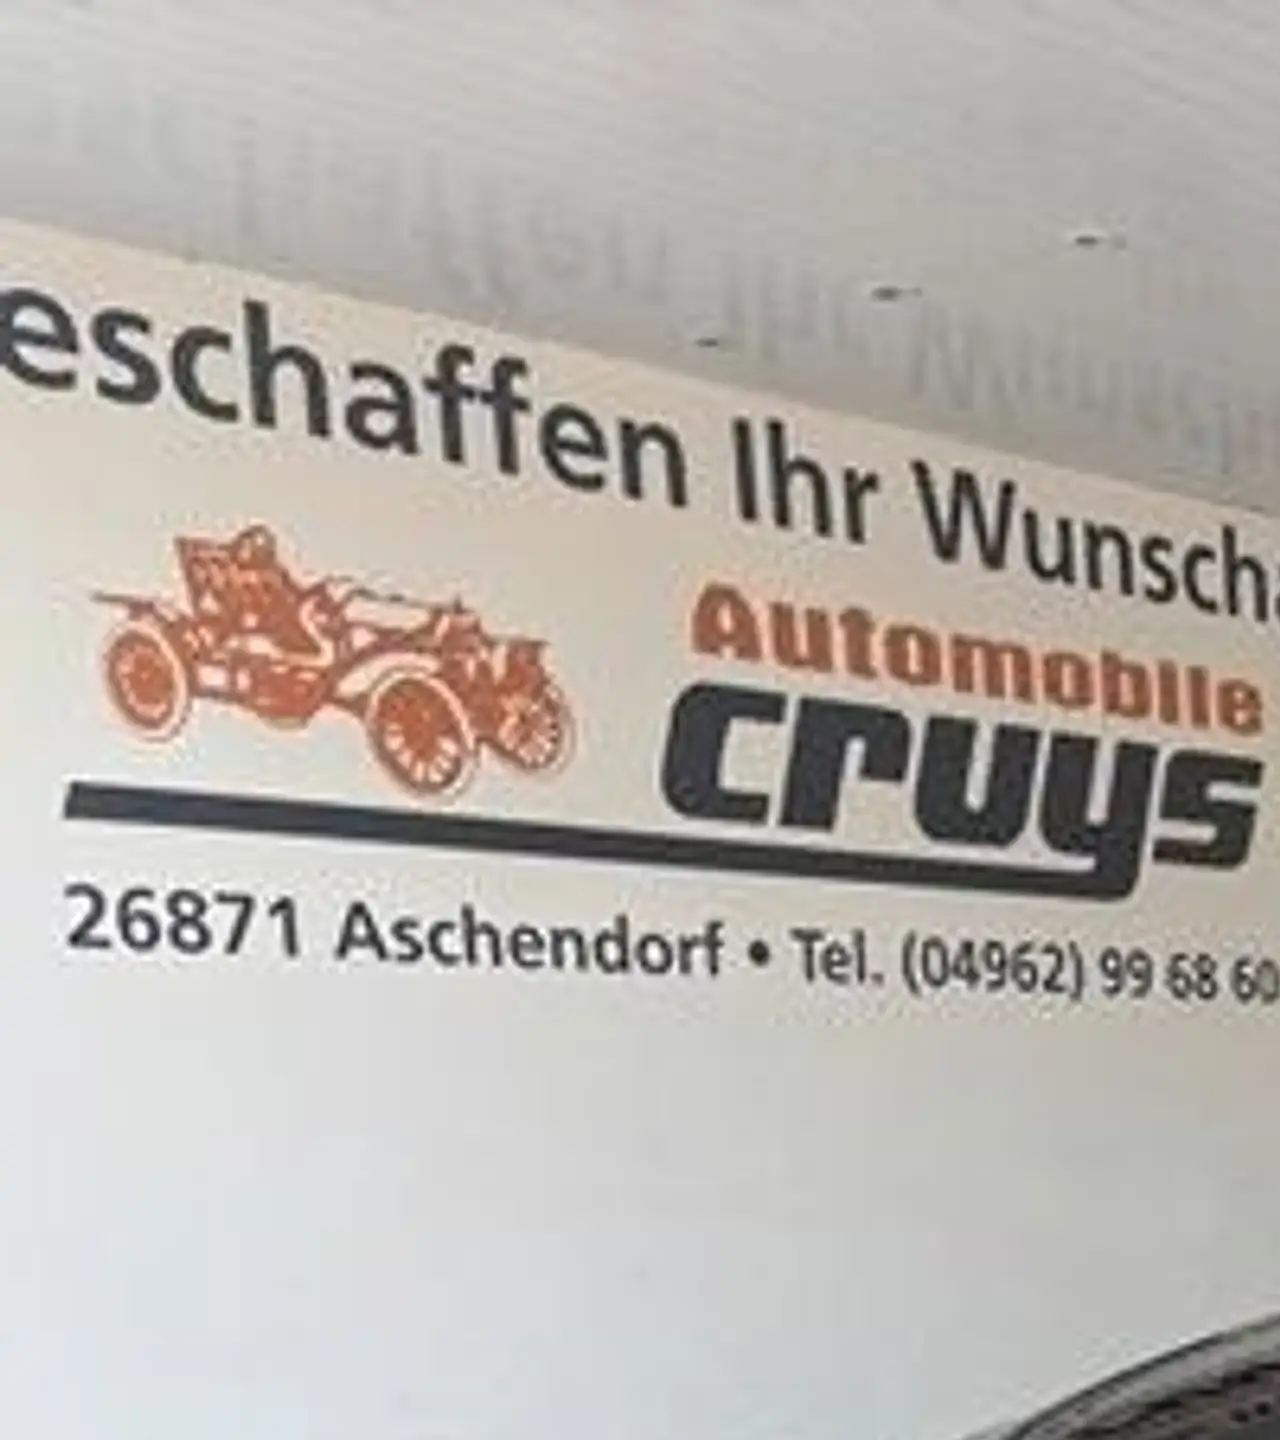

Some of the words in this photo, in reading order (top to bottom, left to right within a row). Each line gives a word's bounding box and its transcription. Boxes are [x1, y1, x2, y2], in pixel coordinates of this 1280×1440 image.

[730, 415, 882, 545] Ihr
[692, 582, 1265, 736] Automobile
[63, 881, 302, 960] 26871
[332, 900, 727, 980] Aschendorf
[788, 927, 885, 987] Tel.
[901, 929, 1088, 1004] (04962)
[1096, 945, 1155, 999] 99
[1162, 951, 1221, 1003] 68
